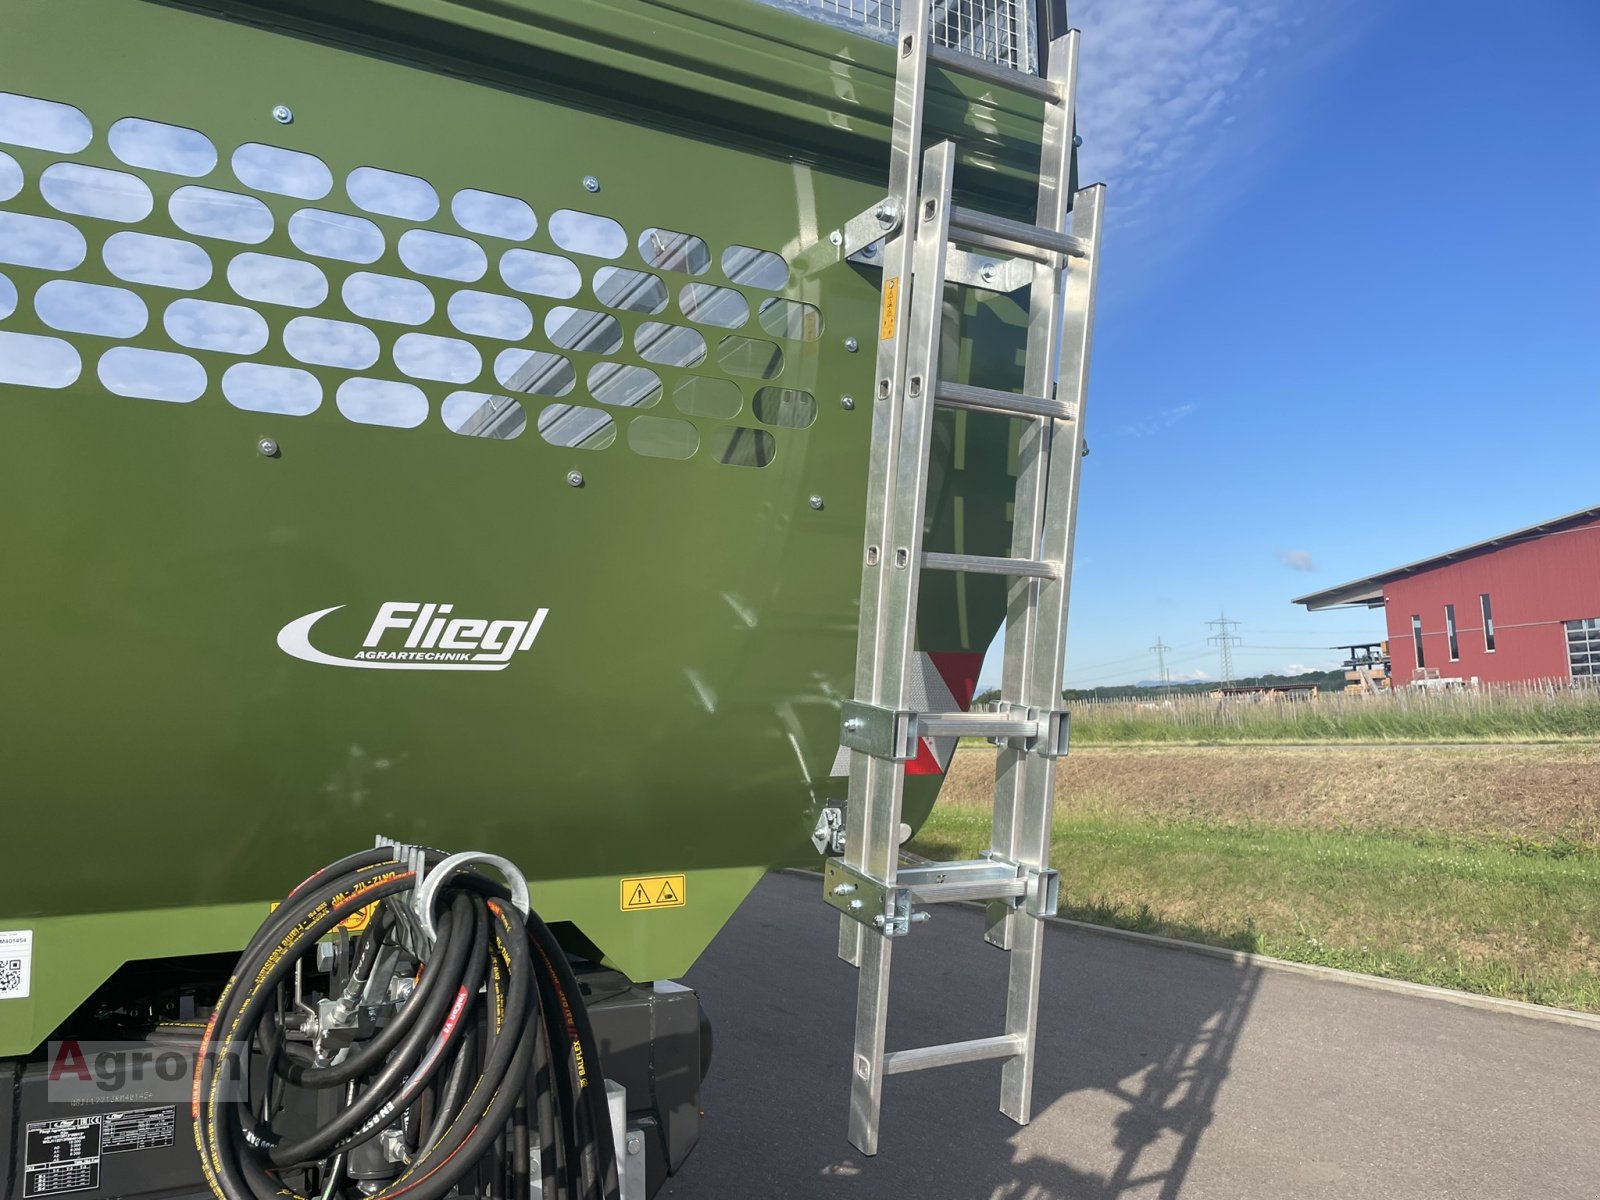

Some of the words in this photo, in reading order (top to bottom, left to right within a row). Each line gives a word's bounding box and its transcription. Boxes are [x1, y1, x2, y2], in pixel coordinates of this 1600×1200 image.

[362, 601, 550, 662] Fliegl
[353, 650, 472, 662] AGRARTECHNIK
[573, 1040, 586, 1076] BALFLEX
[380, 1101, 395, 1118] EN
